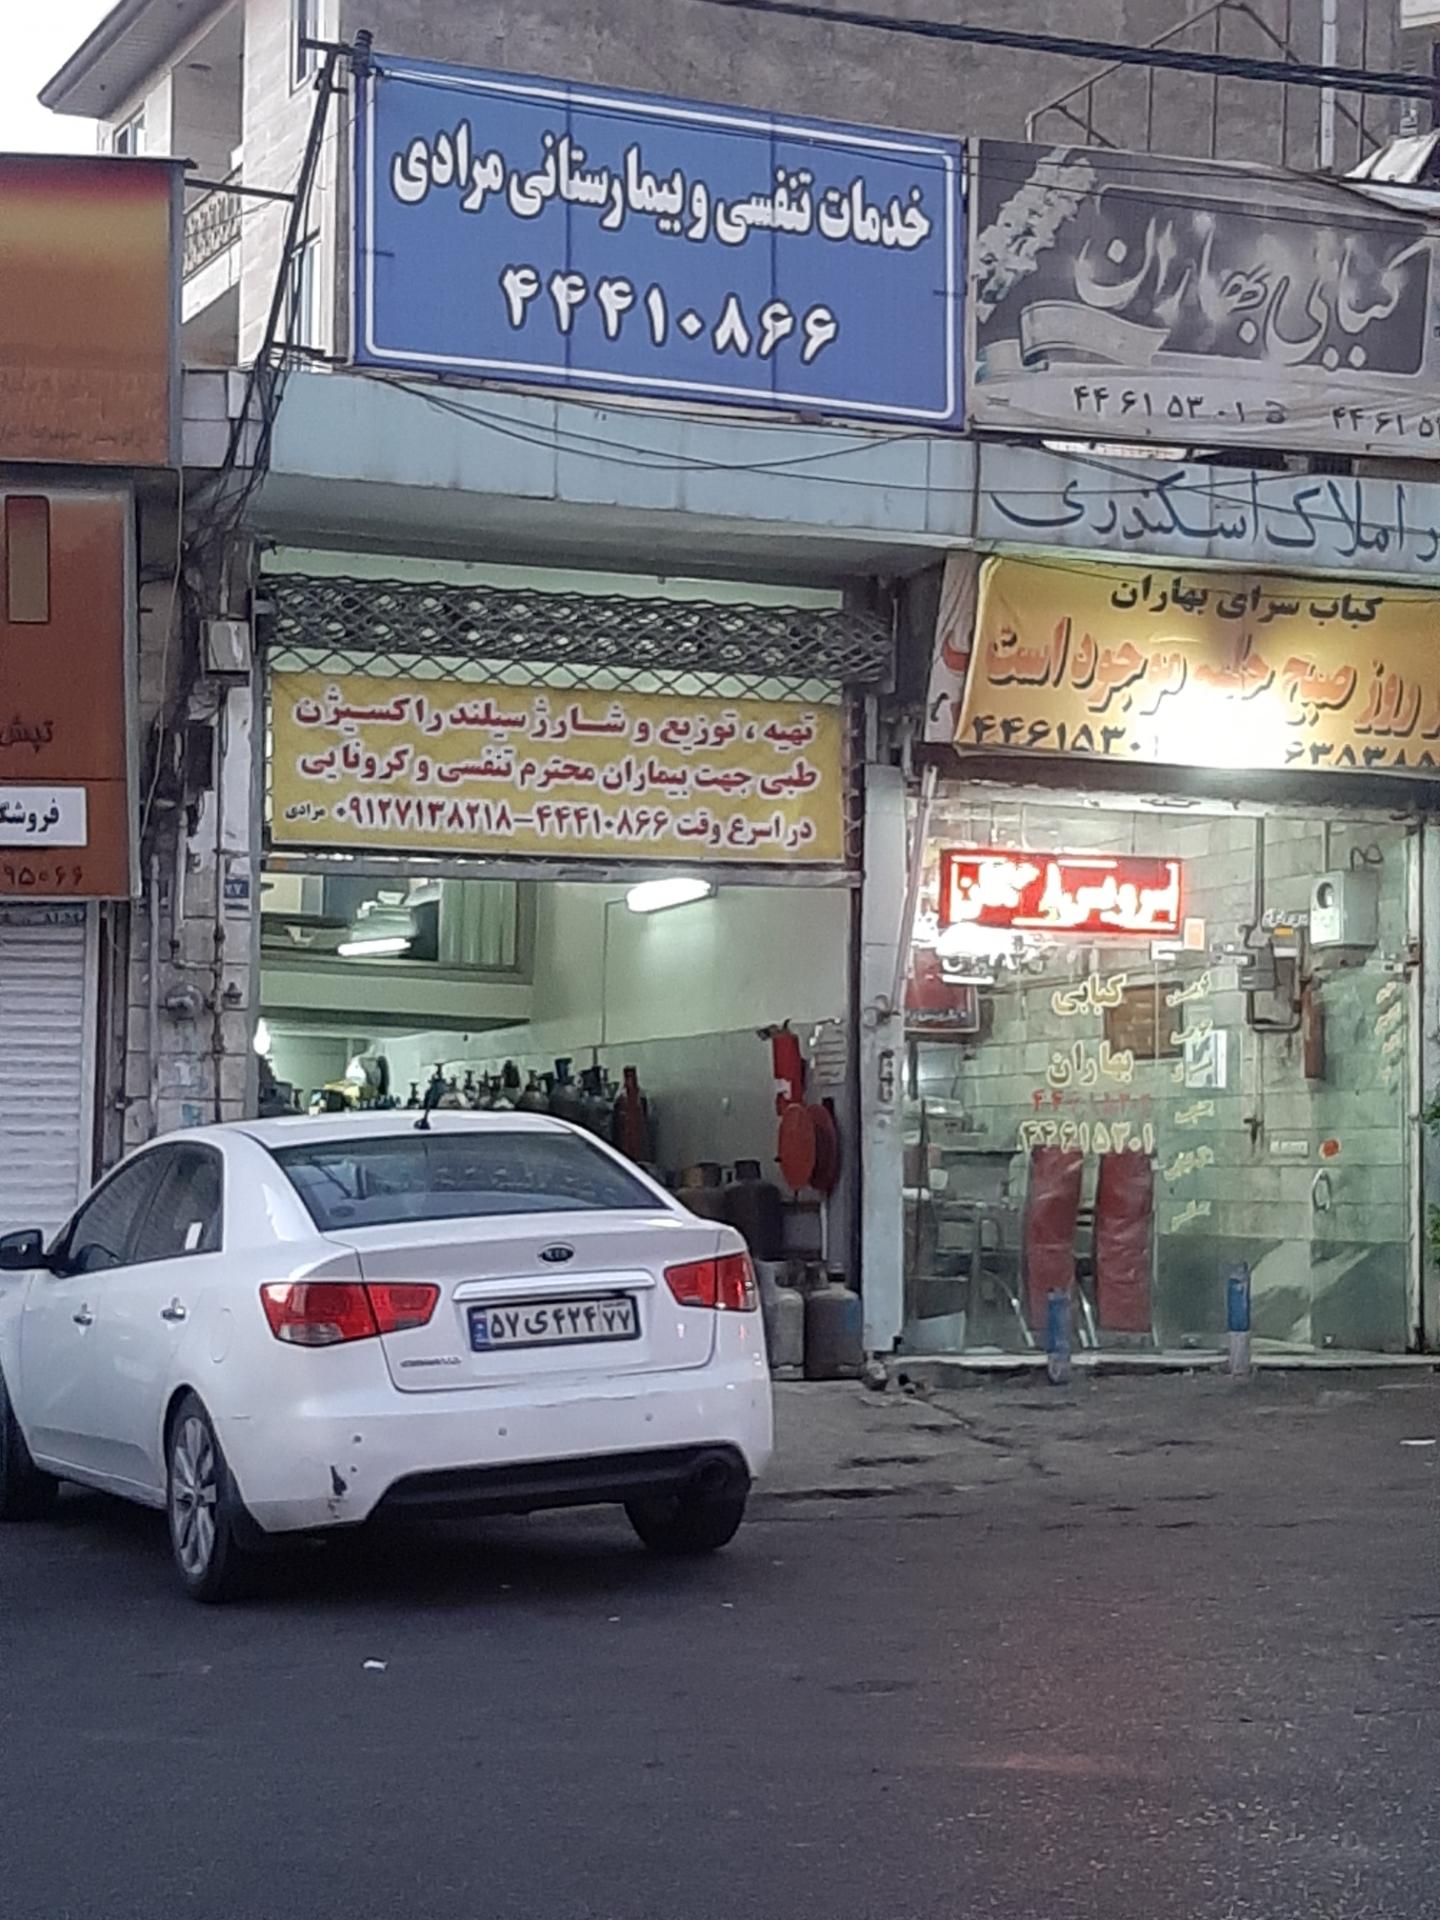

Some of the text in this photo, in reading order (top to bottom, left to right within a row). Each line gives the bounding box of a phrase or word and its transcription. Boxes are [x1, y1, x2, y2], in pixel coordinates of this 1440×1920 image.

[392, 116, 932, 248] خدمات تنفسی و بیمارستانی مرادی
[500, 263, 839, 365] ۴۴۴۱۰۸۶۶
[989, 468, 1260, 545] اسکندری
[1264, 479, 1406, 558] املاک
[1110, 575, 1384, 629] کباب سرای بهاران
[634, 716, 651, 743] و
[658, 712, 737, 751] توزیع
[762, 714, 815, 751] تهیه
[300, 741, 818, 797] طبی جهت بیماران محترم تنفسی و کرونایی
[284, 801, 326, 822] مرادی
[676, 810, 722, 847] وقت
[726, 815, 782, 847] اسرع
[786, 820, 814, 848] در
[1051, 972, 1128, 1016] کبابی
[1046, 1039, 1135, 1088] بهاران
